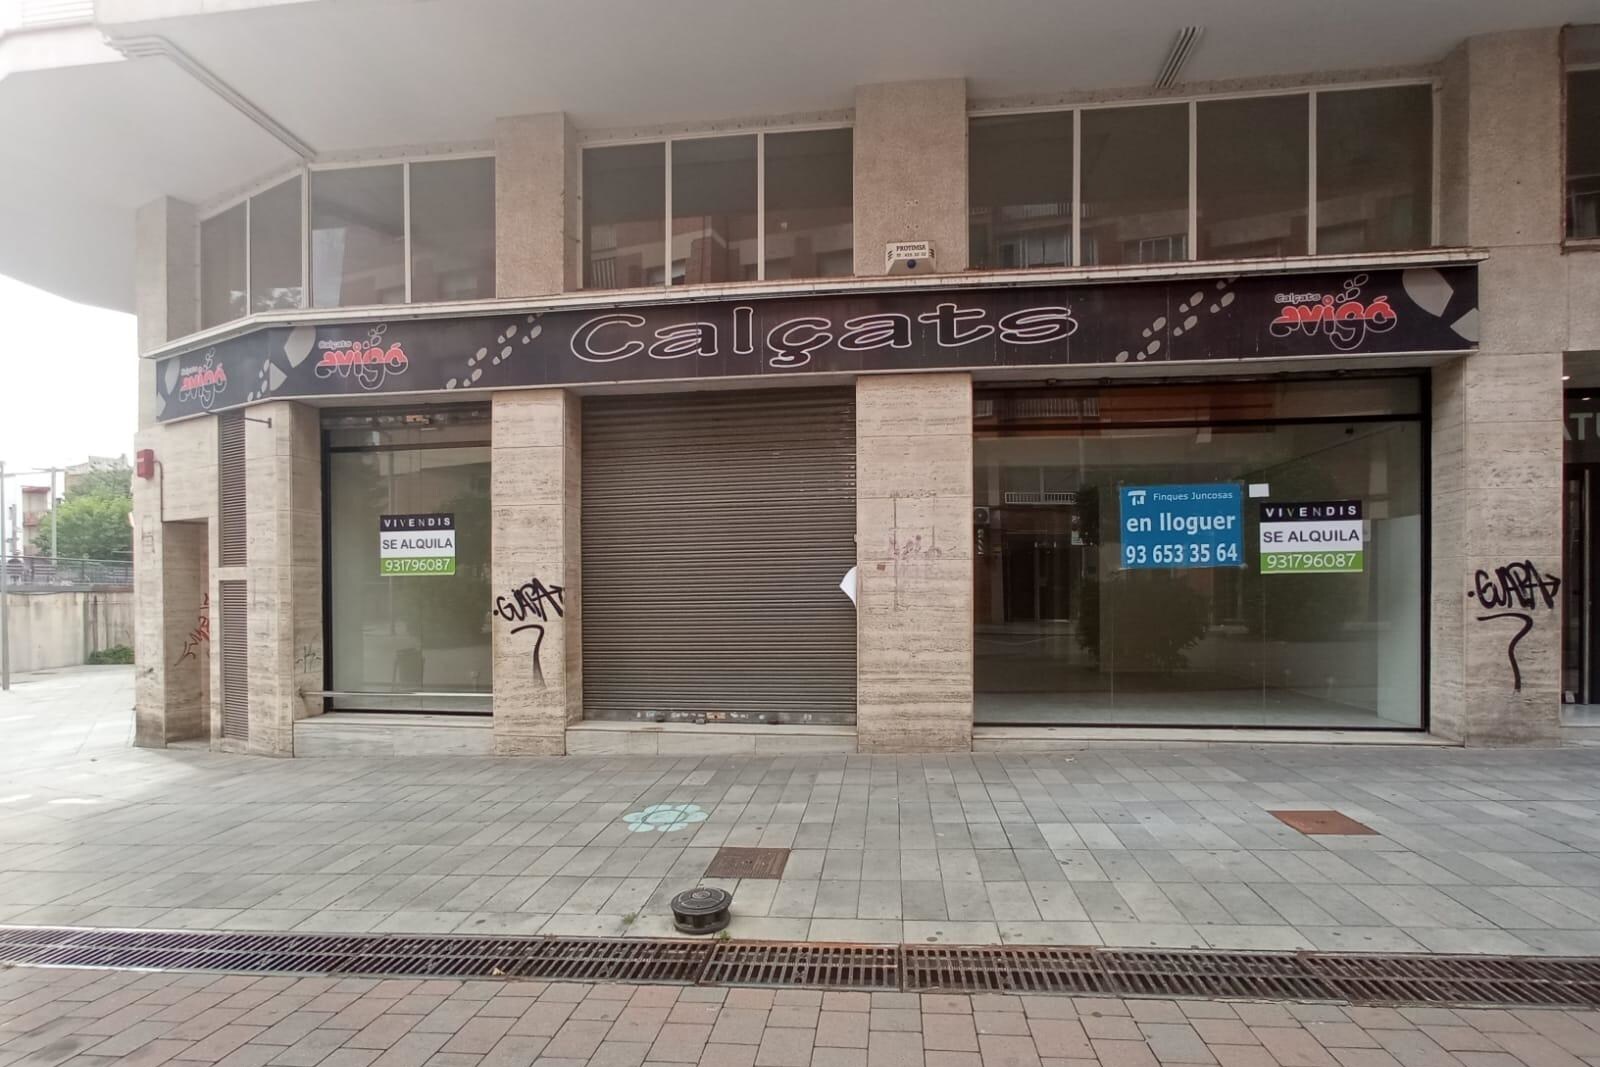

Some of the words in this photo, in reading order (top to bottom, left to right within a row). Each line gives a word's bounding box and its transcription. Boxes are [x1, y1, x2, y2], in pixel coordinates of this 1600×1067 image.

[570, 303, 1078, 368] Calçats
[1153, 492, 1189, 502] Finques
[1191, 491, 1233, 501] Juncosas
[1265, 505, 1357, 518] VIVENDIS
[384, 517, 451, 528] VIVENDIS
[1126, 517, 1152, 532] en
[1159, 512, 1236, 535] lloguer
[1263, 531, 1284, 543] SE
[1287, 529, 1360, 543] ALQUILA
[382, 539, 398, 550] SE
[400, 537, 453, 549] ALQUILA
[1126, 545, 1147, 564] 93
[1152, 544, 1184, 563] 653
[1189, 543, 1211, 563] 35
[1216, 543, 1238, 562] 64
[384, 558, 451, 571] 931796087
[1266, 552, 1356, 569] 931796087
